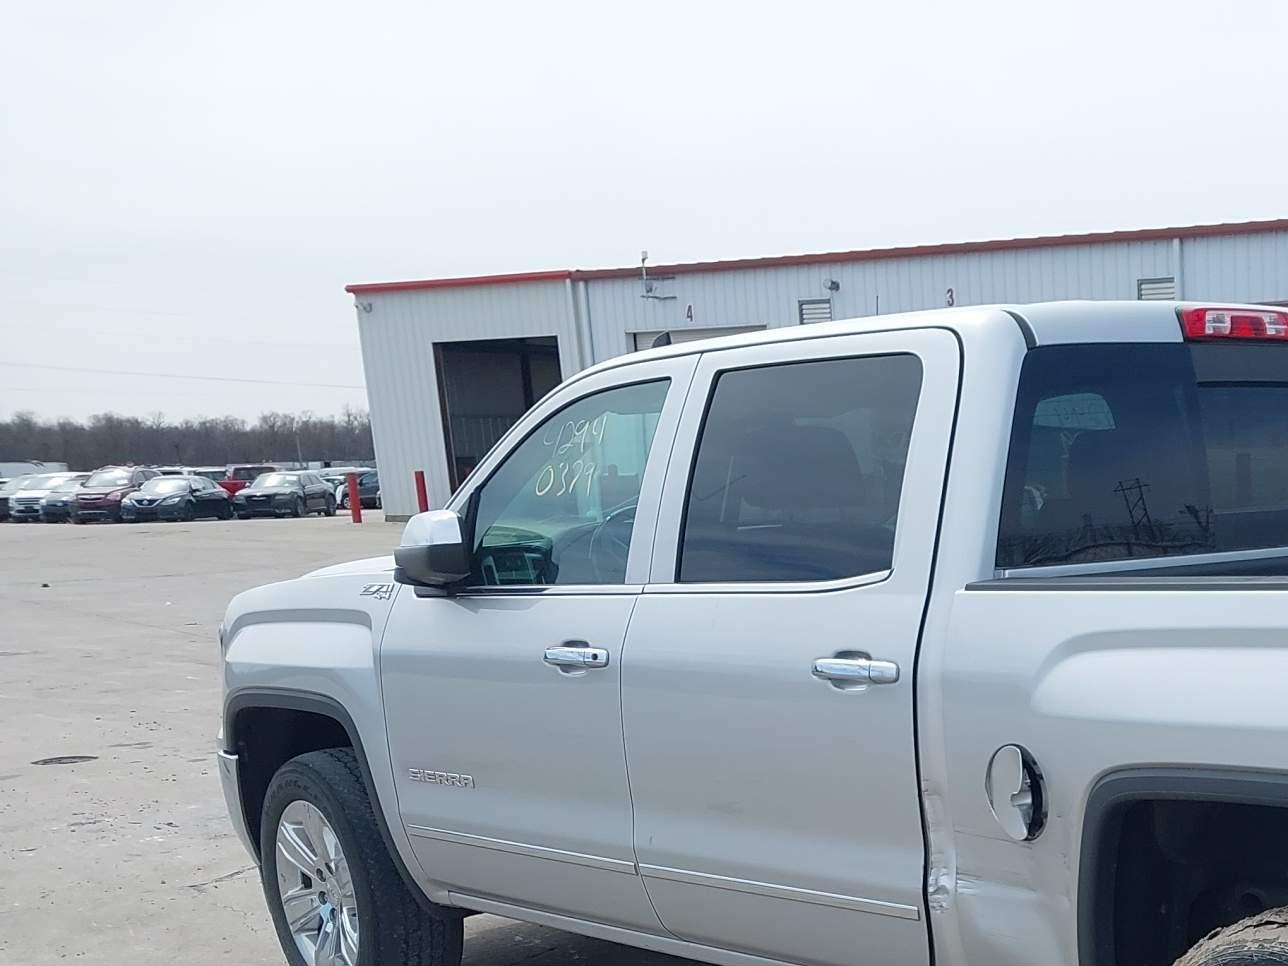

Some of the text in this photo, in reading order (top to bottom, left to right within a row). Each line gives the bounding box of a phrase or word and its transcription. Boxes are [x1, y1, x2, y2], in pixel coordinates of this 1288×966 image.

[946, 287, 955, 307] 3
[686, 304, 693, 322] 4
[408, 767, 476, 790] SIERRA
